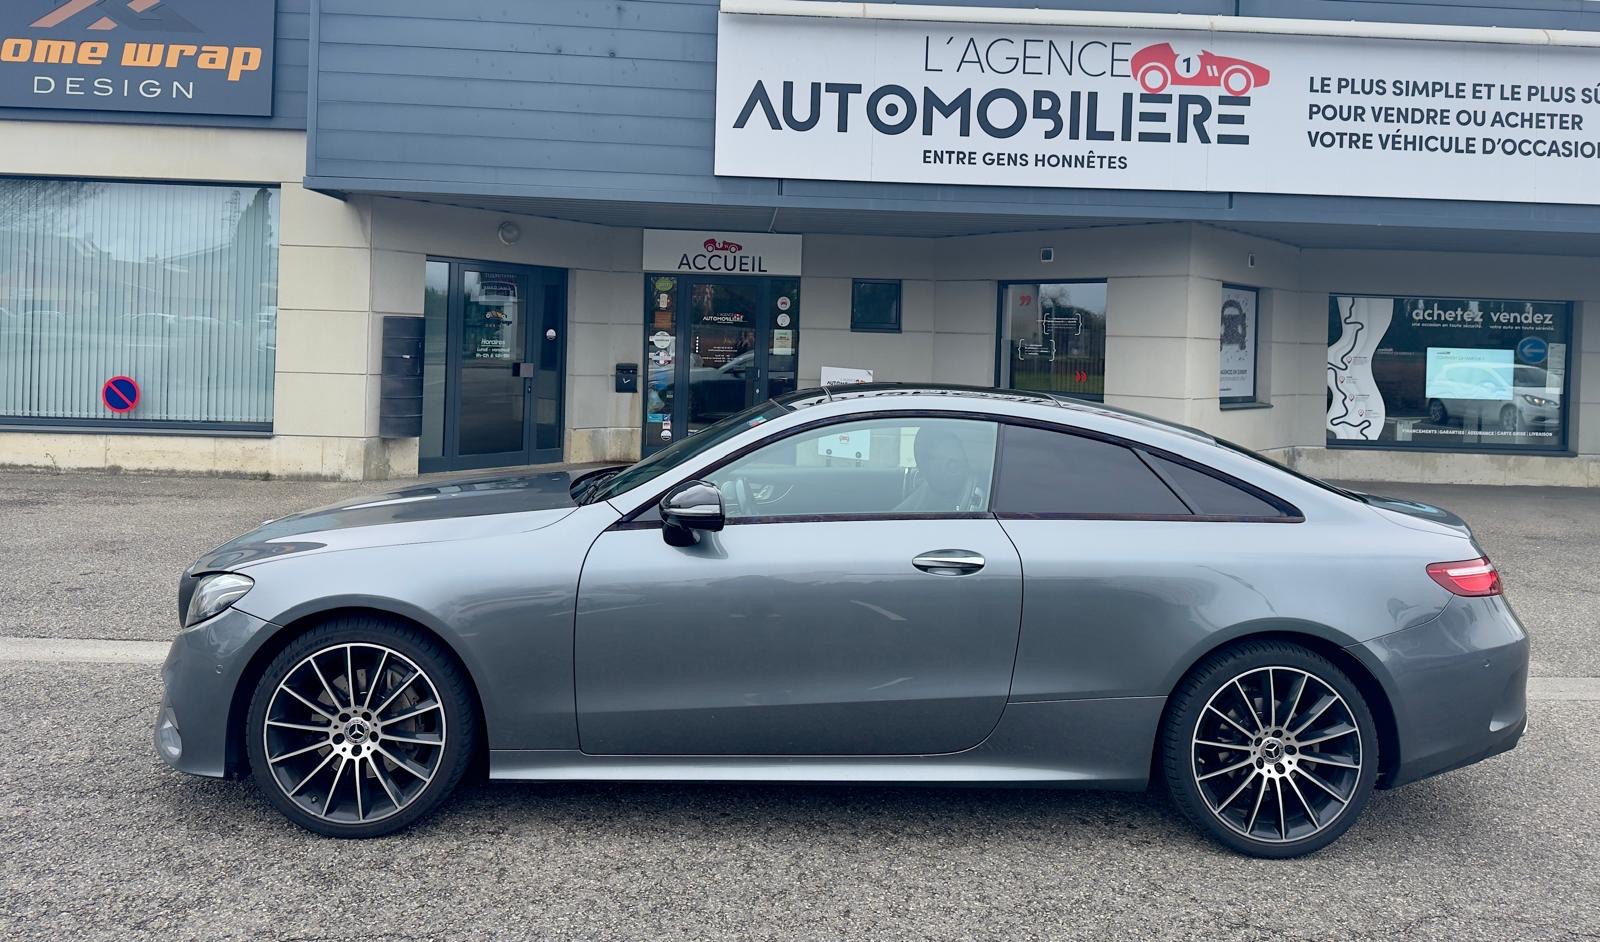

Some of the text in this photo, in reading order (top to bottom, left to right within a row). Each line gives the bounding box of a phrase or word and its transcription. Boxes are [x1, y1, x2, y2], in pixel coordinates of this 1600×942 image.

[0, 38, 262, 81] ome wrap
[924, 36, 1131, 78] L'AGENCE
[1182, 57, 1191, 73] 1
[33, 76, 194, 99] DESIGN
[1309, 76, 1332, 94] LE
[1337, 77, 1387, 96] PLUS
[1392, 80, 1466, 99] SIMPLE
[1472, 82, 1495, 100] ET
[1500, 84, 1521, 102] LE
[1527, 85, 1576, 104] PLUS
[733, 80, 1251, 145] AUTOMOBILIERE
[1308, 103, 1583, 131] POUR VENDRE OU ACHETER
[1307, 129, 1600, 159] VOTRE VÉHICULE D'OCCASIO
[922, 150, 1128, 170] ENTRE GENS HONNÊTES
[678, 253, 767, 273] ACCUEIL
[1412, 303, 1483, 322] achetez
[1490, 307, 1553, 324] vendez
